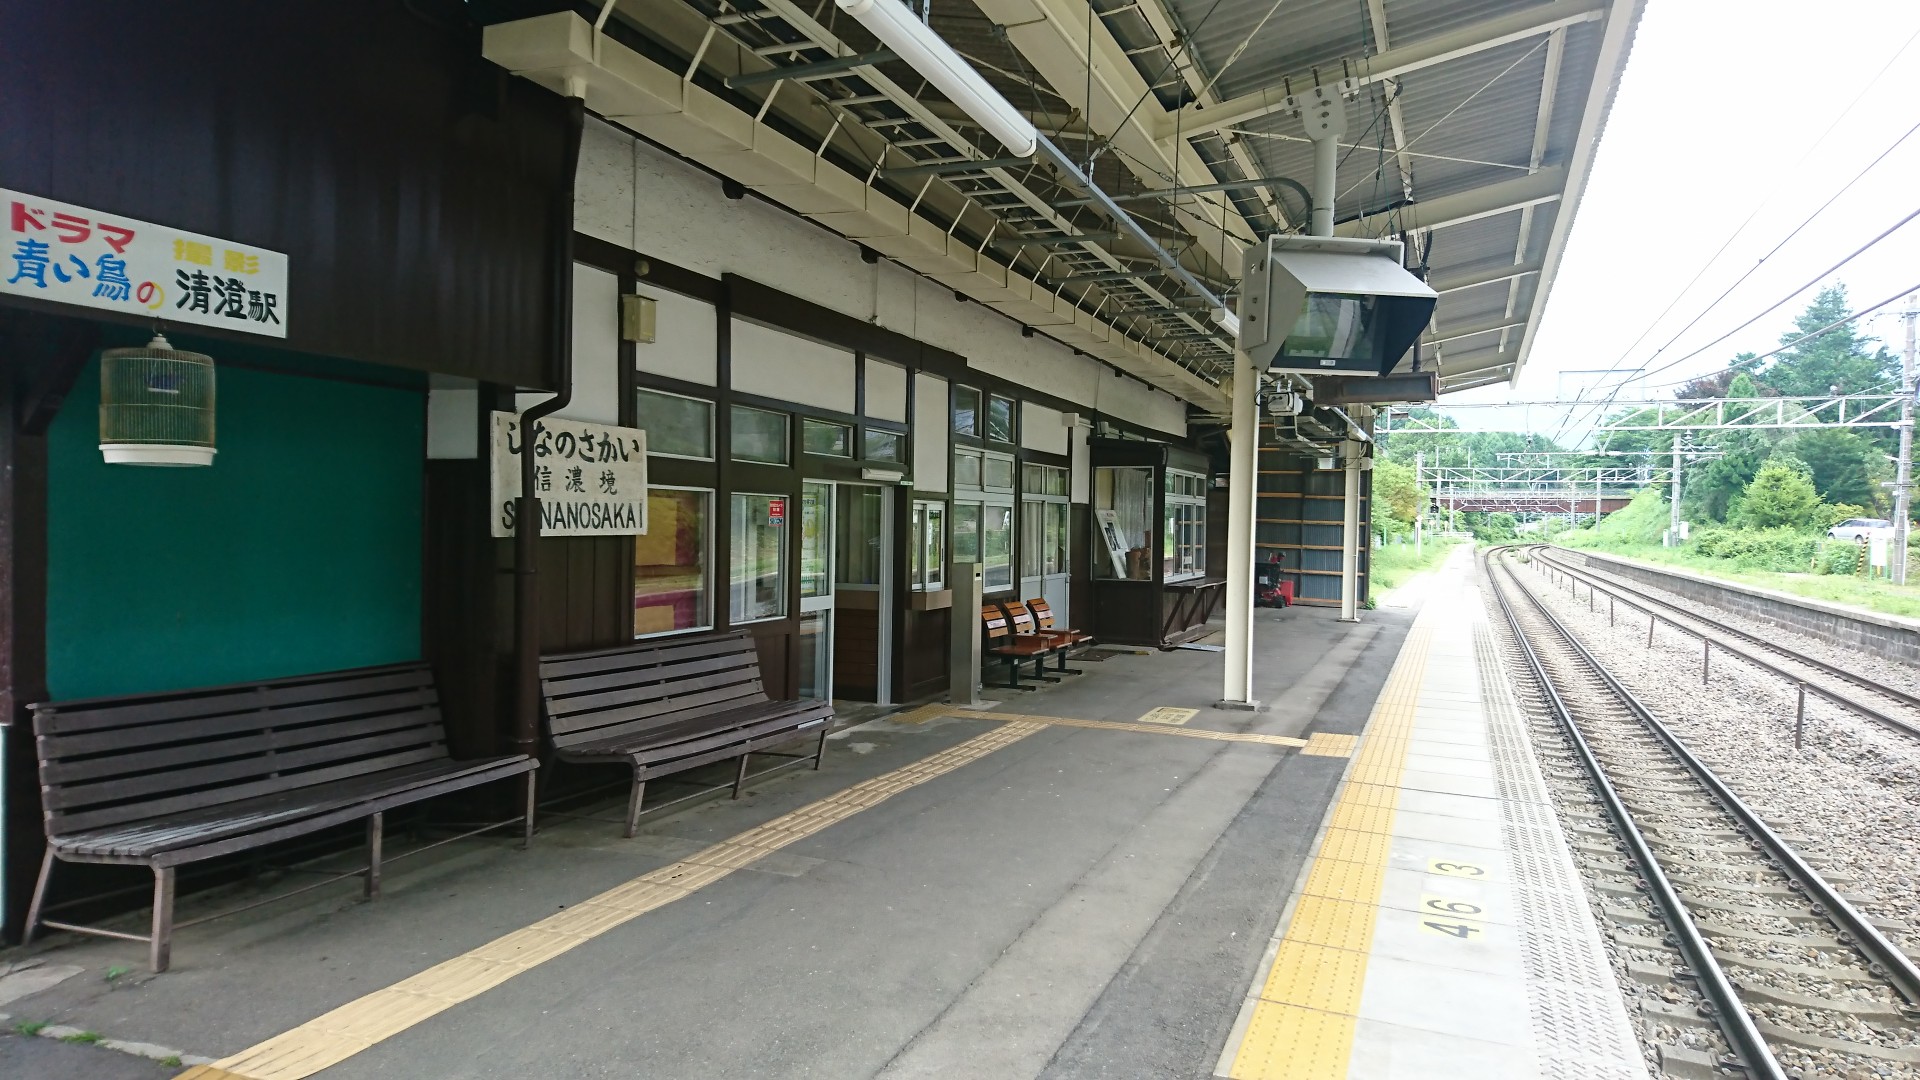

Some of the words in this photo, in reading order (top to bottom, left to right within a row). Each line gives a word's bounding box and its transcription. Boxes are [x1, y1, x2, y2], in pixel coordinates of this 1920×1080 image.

[11, 201, 135, 254] ドラマ
[172, 238, 260, 275] 撮影
[175, 268, 280, 325] 清澄駅
[502, 500, 643, 529] SNANOSAKAI
